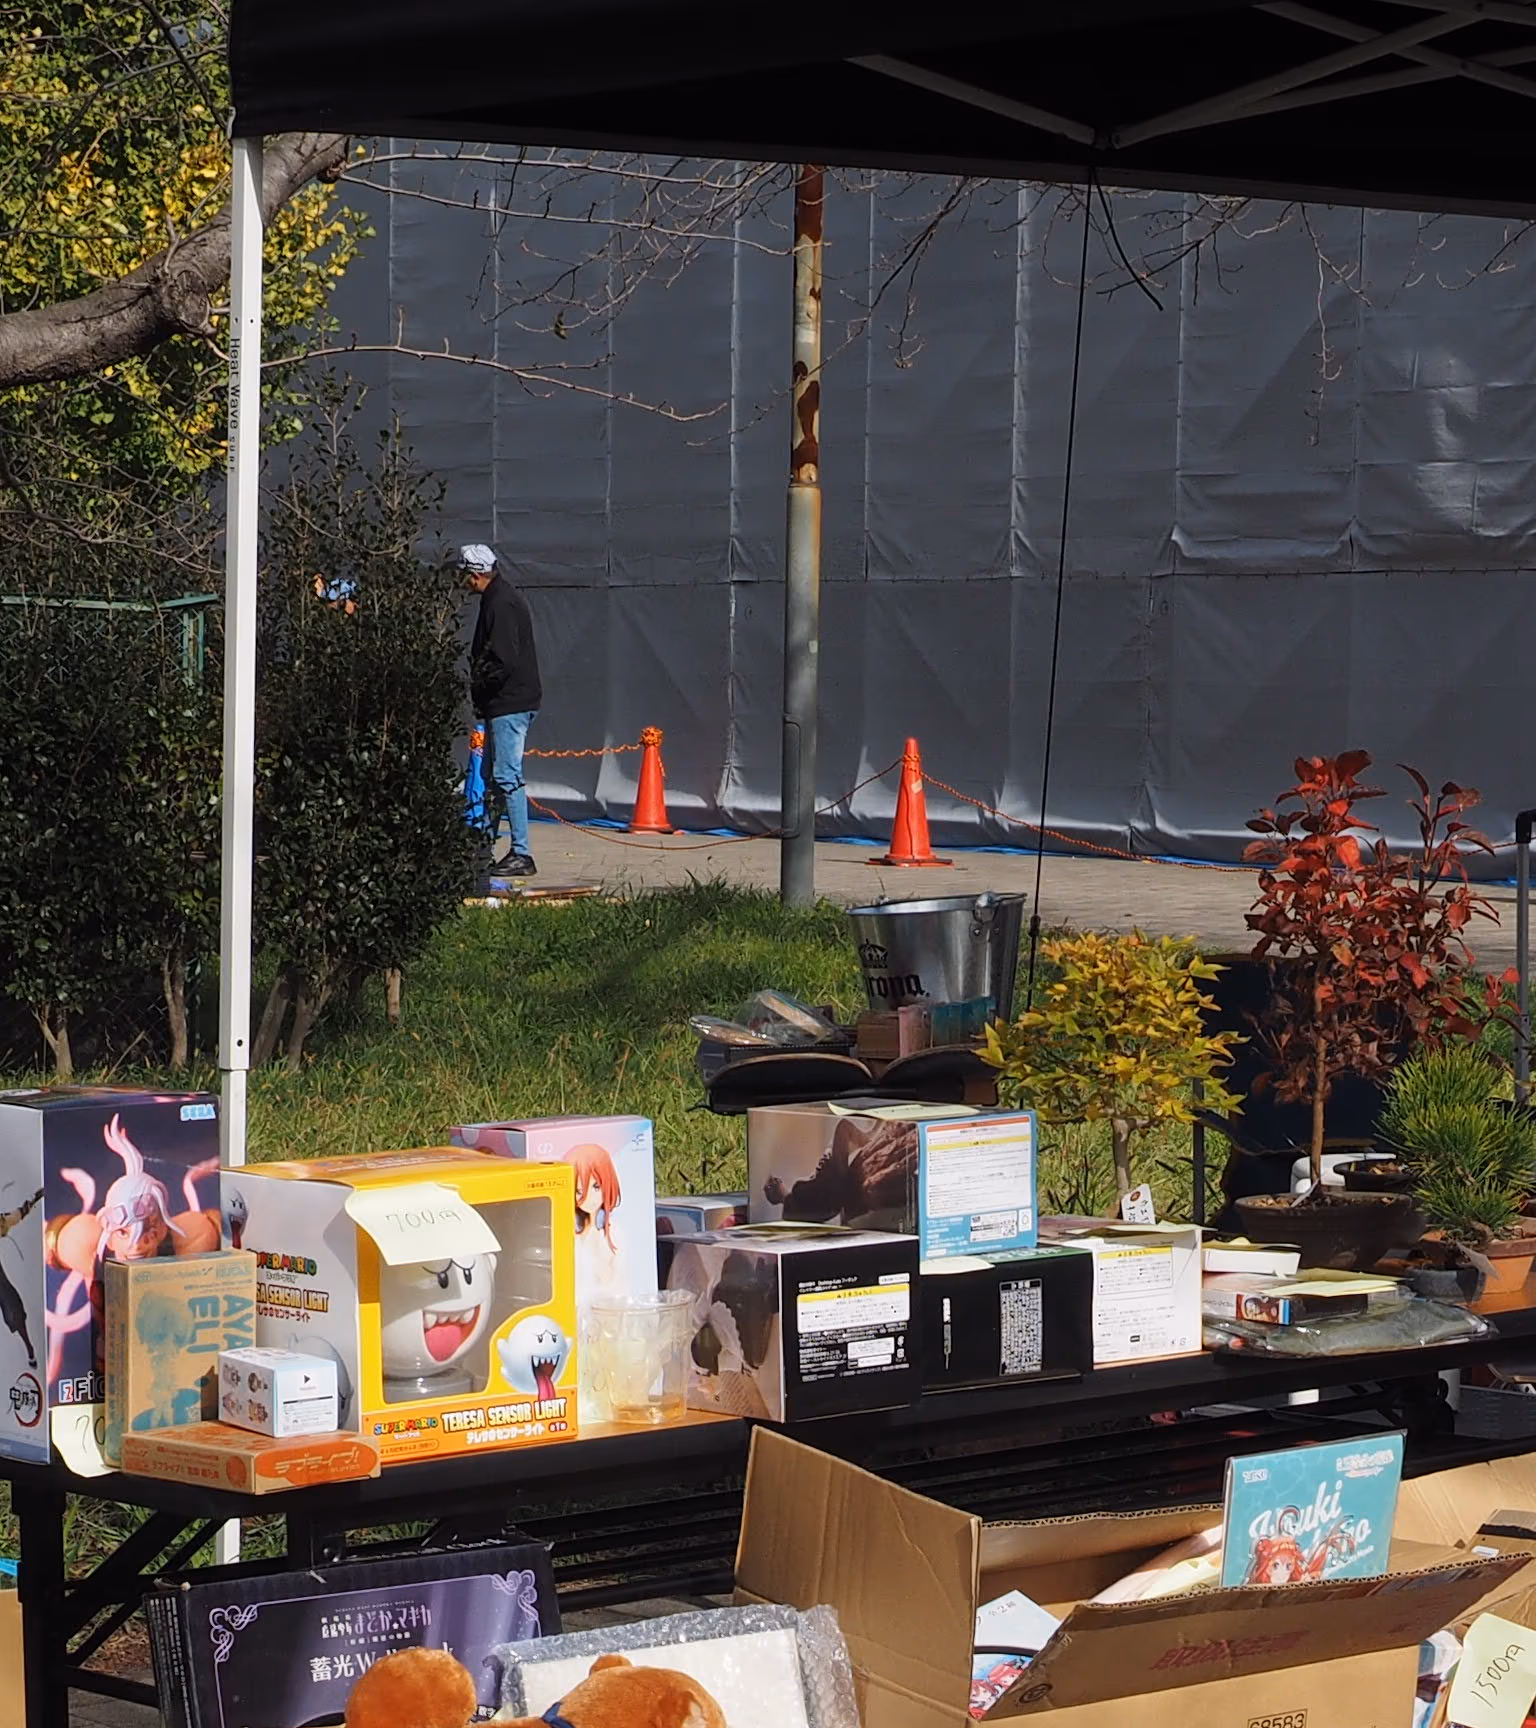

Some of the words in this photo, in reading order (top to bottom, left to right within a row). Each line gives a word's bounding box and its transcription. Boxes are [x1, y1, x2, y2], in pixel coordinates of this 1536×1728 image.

[180, 1105, 216, 1121] SEGA
[282, 1253, 317, 1276] MARIO
[267, 1284, 301, 1308] SENSOR
[302, 1290, 329, 1313] LIGHT
[373, 1419, 404, 1436] SUPER
[405, 1416, 439, 1433] MARIO
[440, 1410, 485, 1432] TERESA
[489, 1402, 533, 1427] SENSOR
[535, 1397, 568, 1421] LIGHT
[309, 1654, 355, 1683] 蓄光
